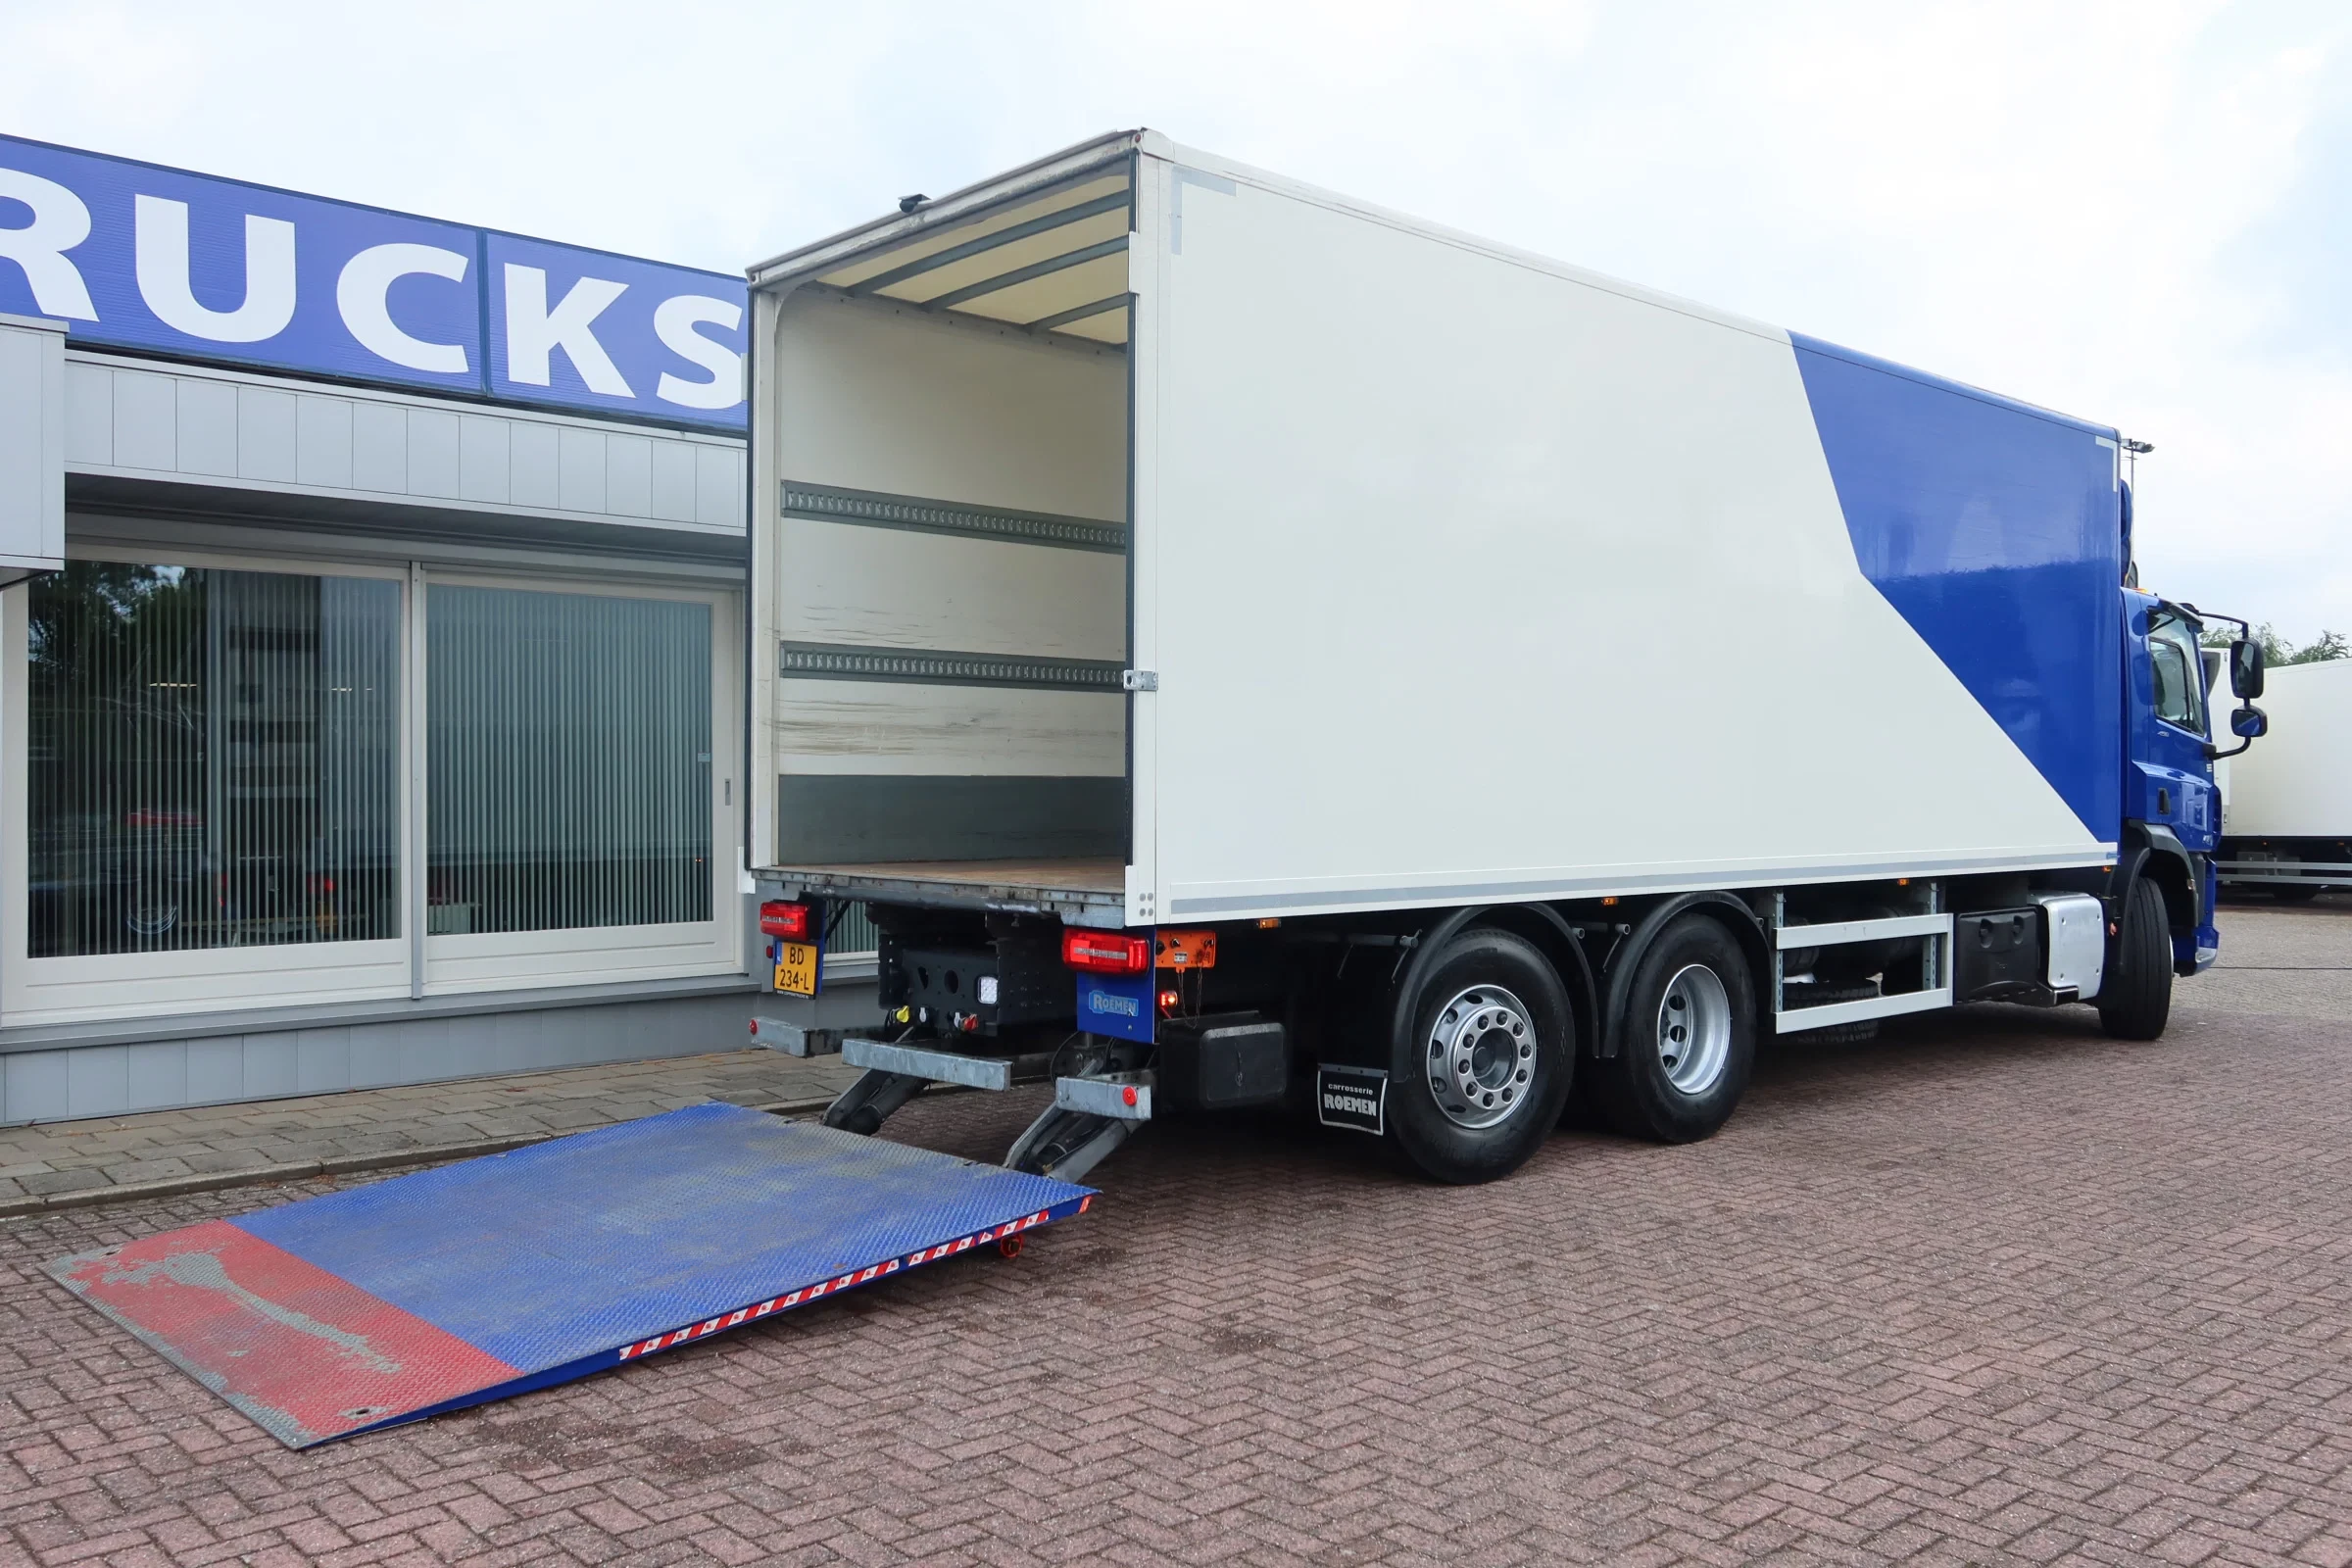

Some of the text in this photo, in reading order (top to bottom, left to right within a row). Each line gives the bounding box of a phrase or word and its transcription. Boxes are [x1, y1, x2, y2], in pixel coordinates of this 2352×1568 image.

[0, 167, 744, 410] RUCKS
[789, 947, 805, 965] BD
[779, 968, 809, 991] 234-L
[1093, 994, 1137, 1014] ROEMEN
[1328, 1083, 1374, 1096] carrosserie
[1323, 1093, 1377, 1117] ROEMEN
